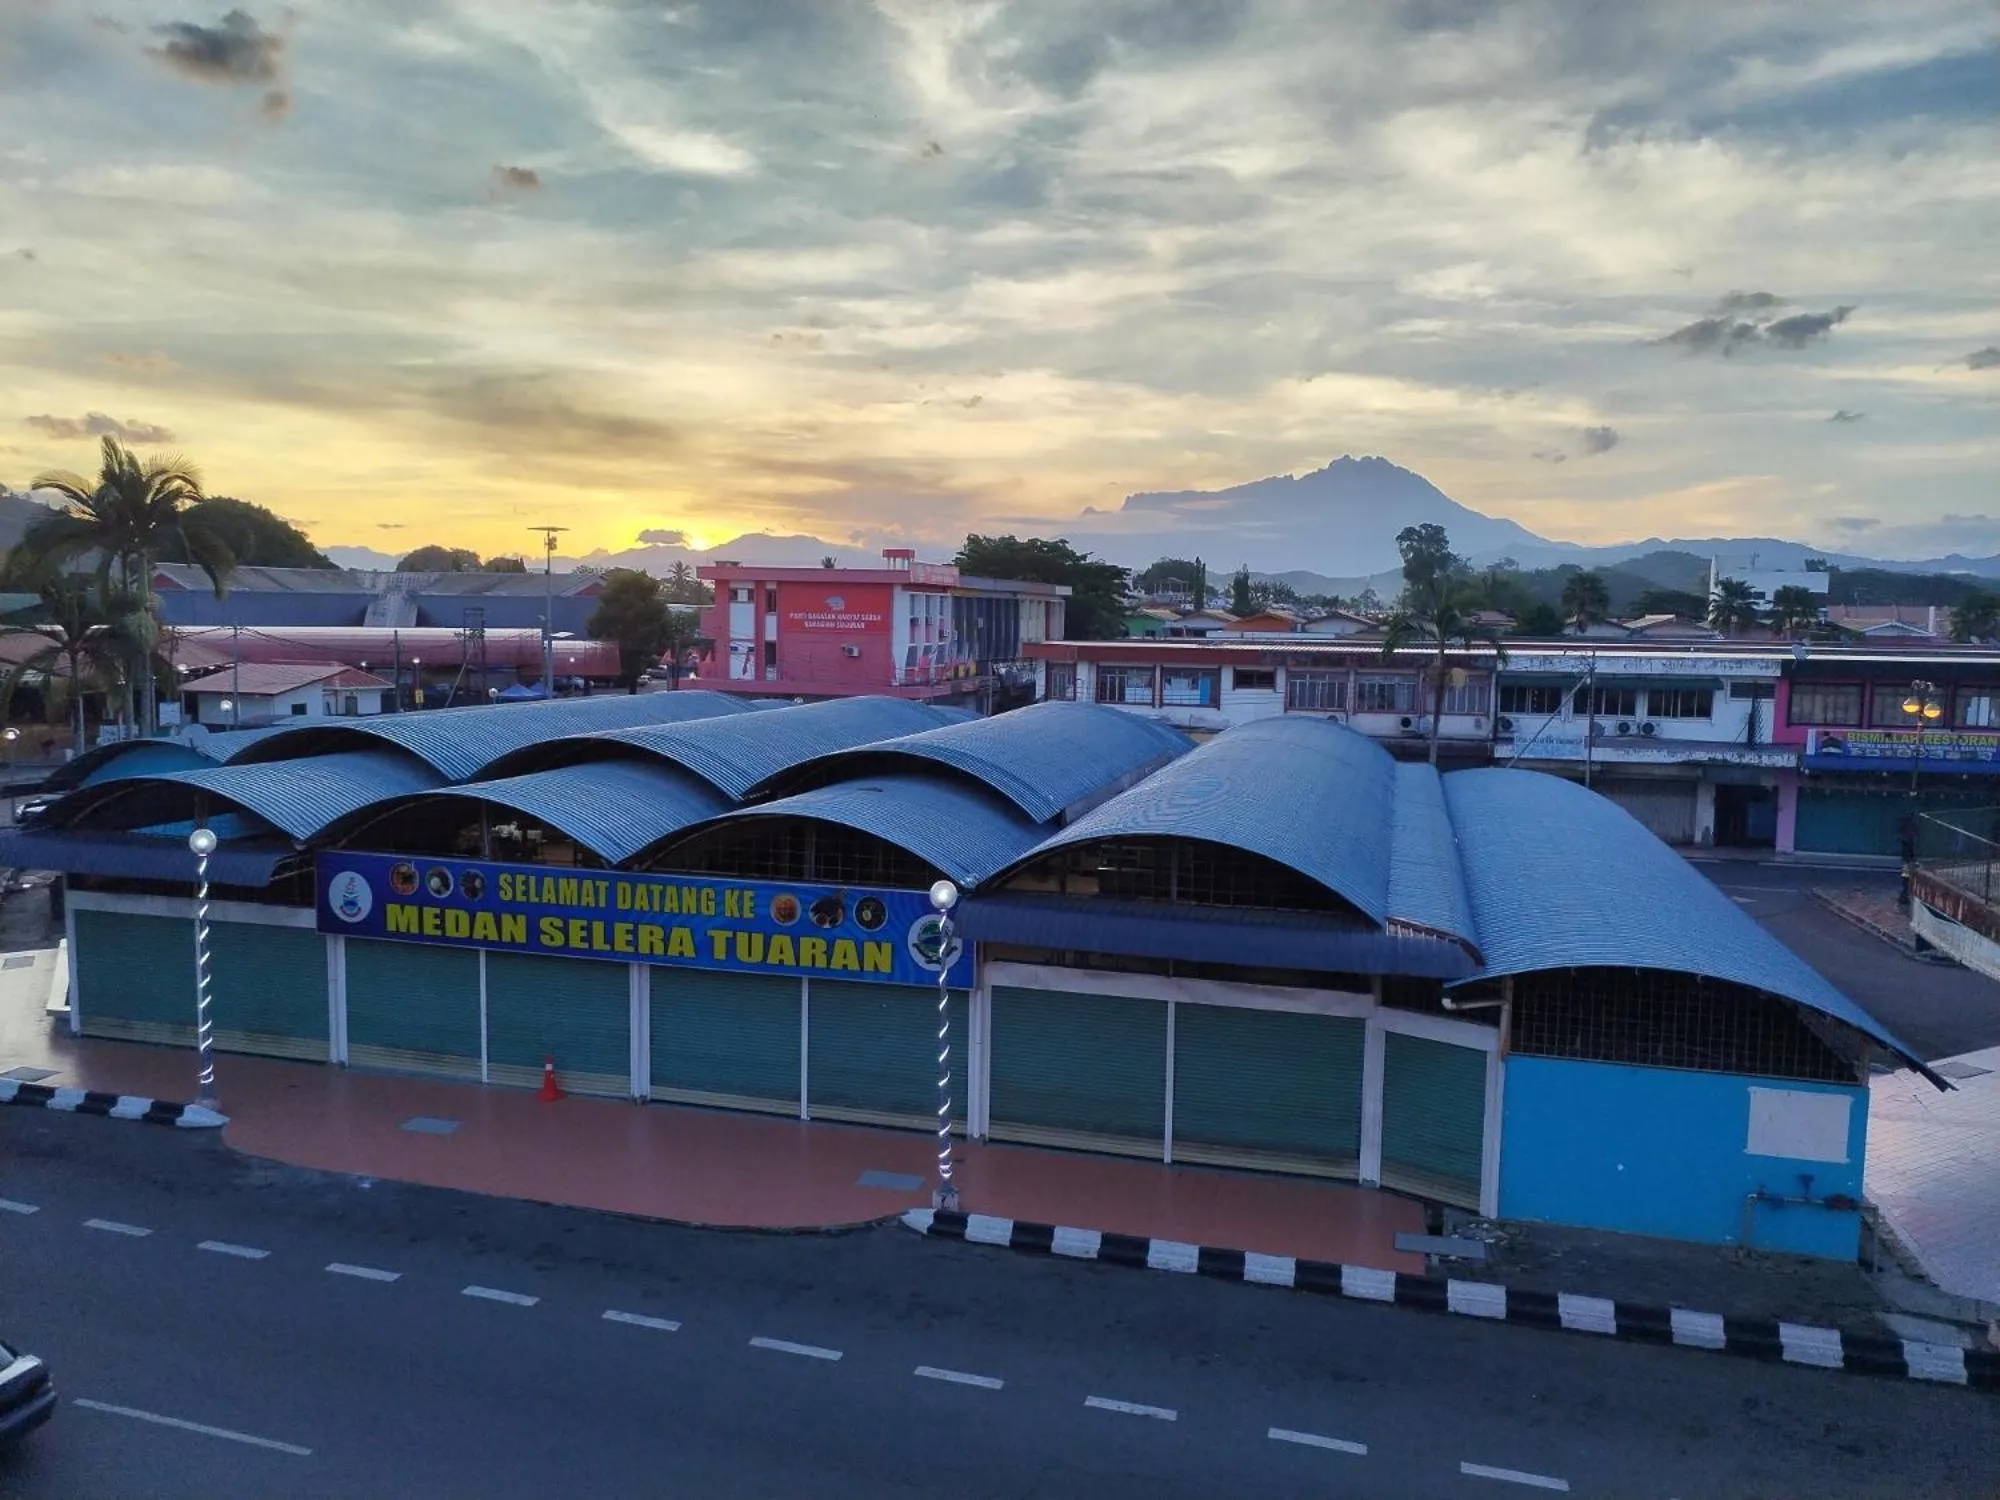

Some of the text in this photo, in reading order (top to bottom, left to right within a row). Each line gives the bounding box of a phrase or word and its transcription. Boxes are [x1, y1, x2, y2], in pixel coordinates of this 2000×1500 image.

[1847, 731, 1998, 746] BISMILLAH RESTORAN
[499, 872, 756, 919] SELAMAT DATANG KE
[386, 903, 893, 974] MEDAN SELERA TUARAN
